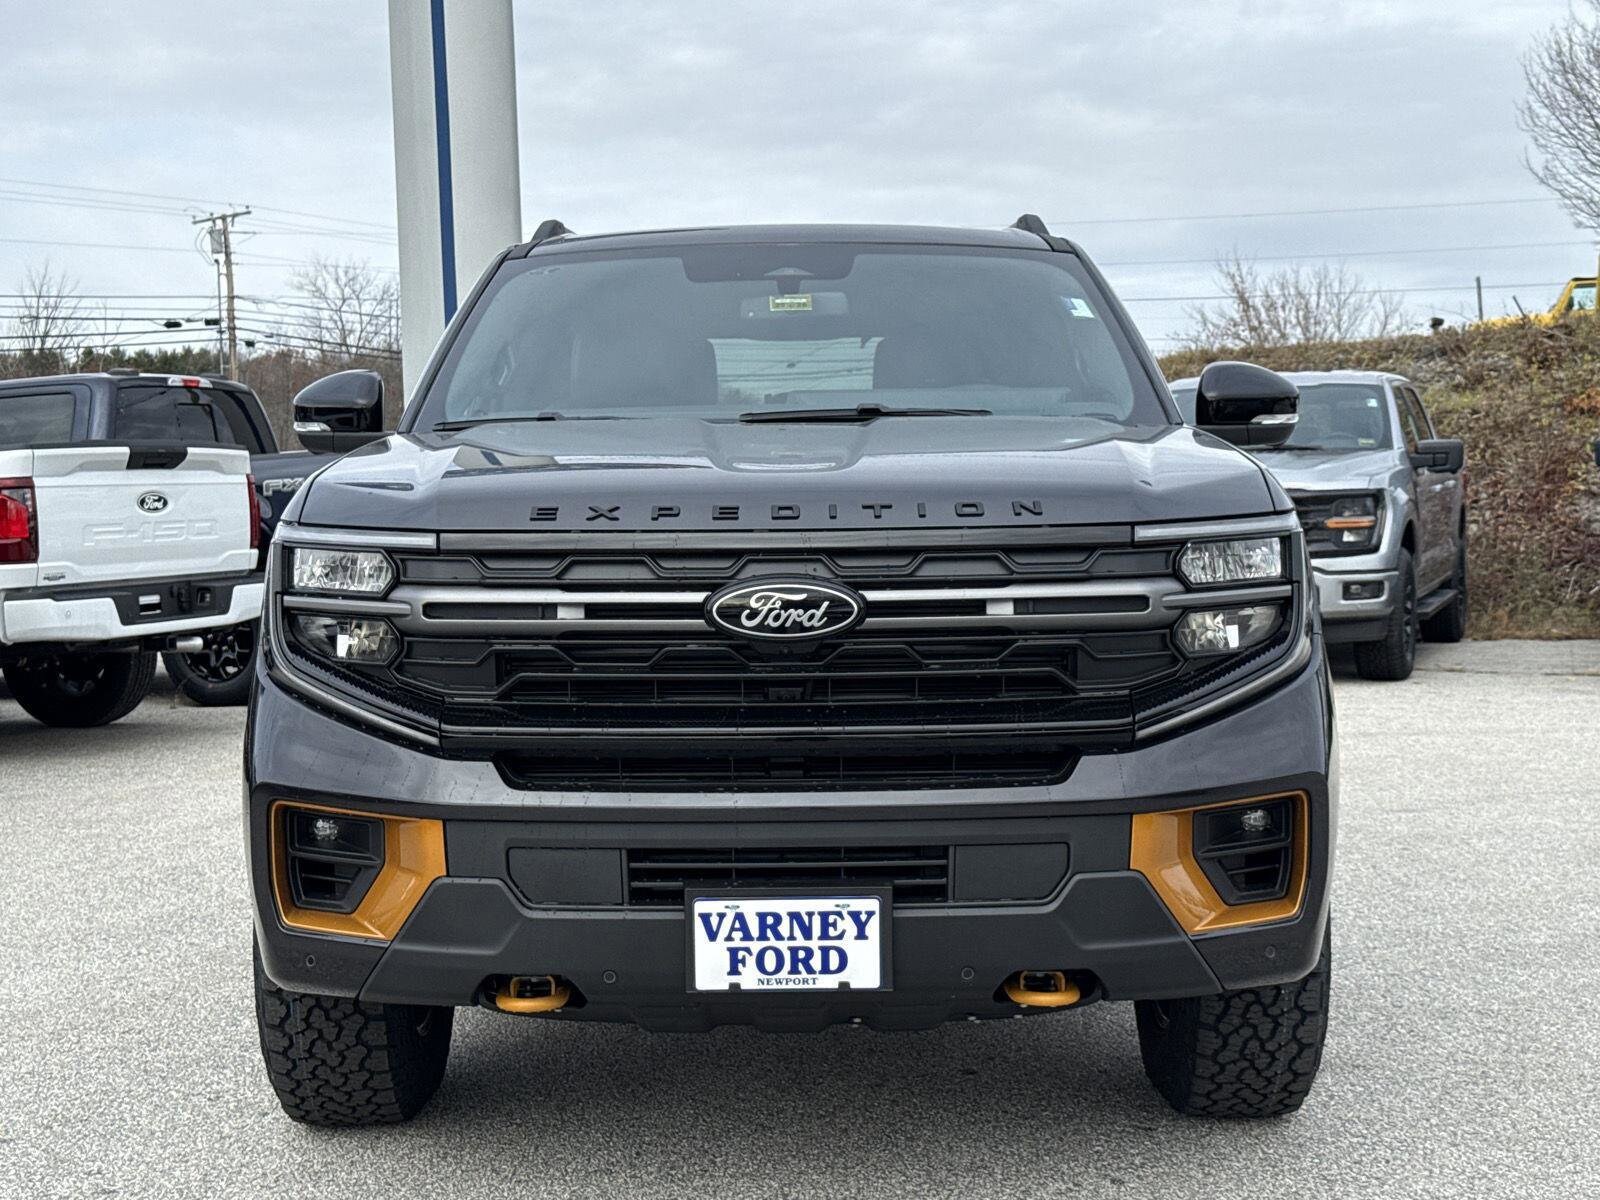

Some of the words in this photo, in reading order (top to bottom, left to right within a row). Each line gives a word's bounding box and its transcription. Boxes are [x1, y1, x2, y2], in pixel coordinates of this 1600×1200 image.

[143, 495, 164, 509] Ford
[530, 500, 1043, 521] EXPEDITION
[82, 519, 219, 546] F-150
[741, 591, 830, 628] Ford
[698, 911, 876, 942] VARNEY
[727, 945, 848, 976] FORD
[757, 977, 819, 986] NEWPORT
